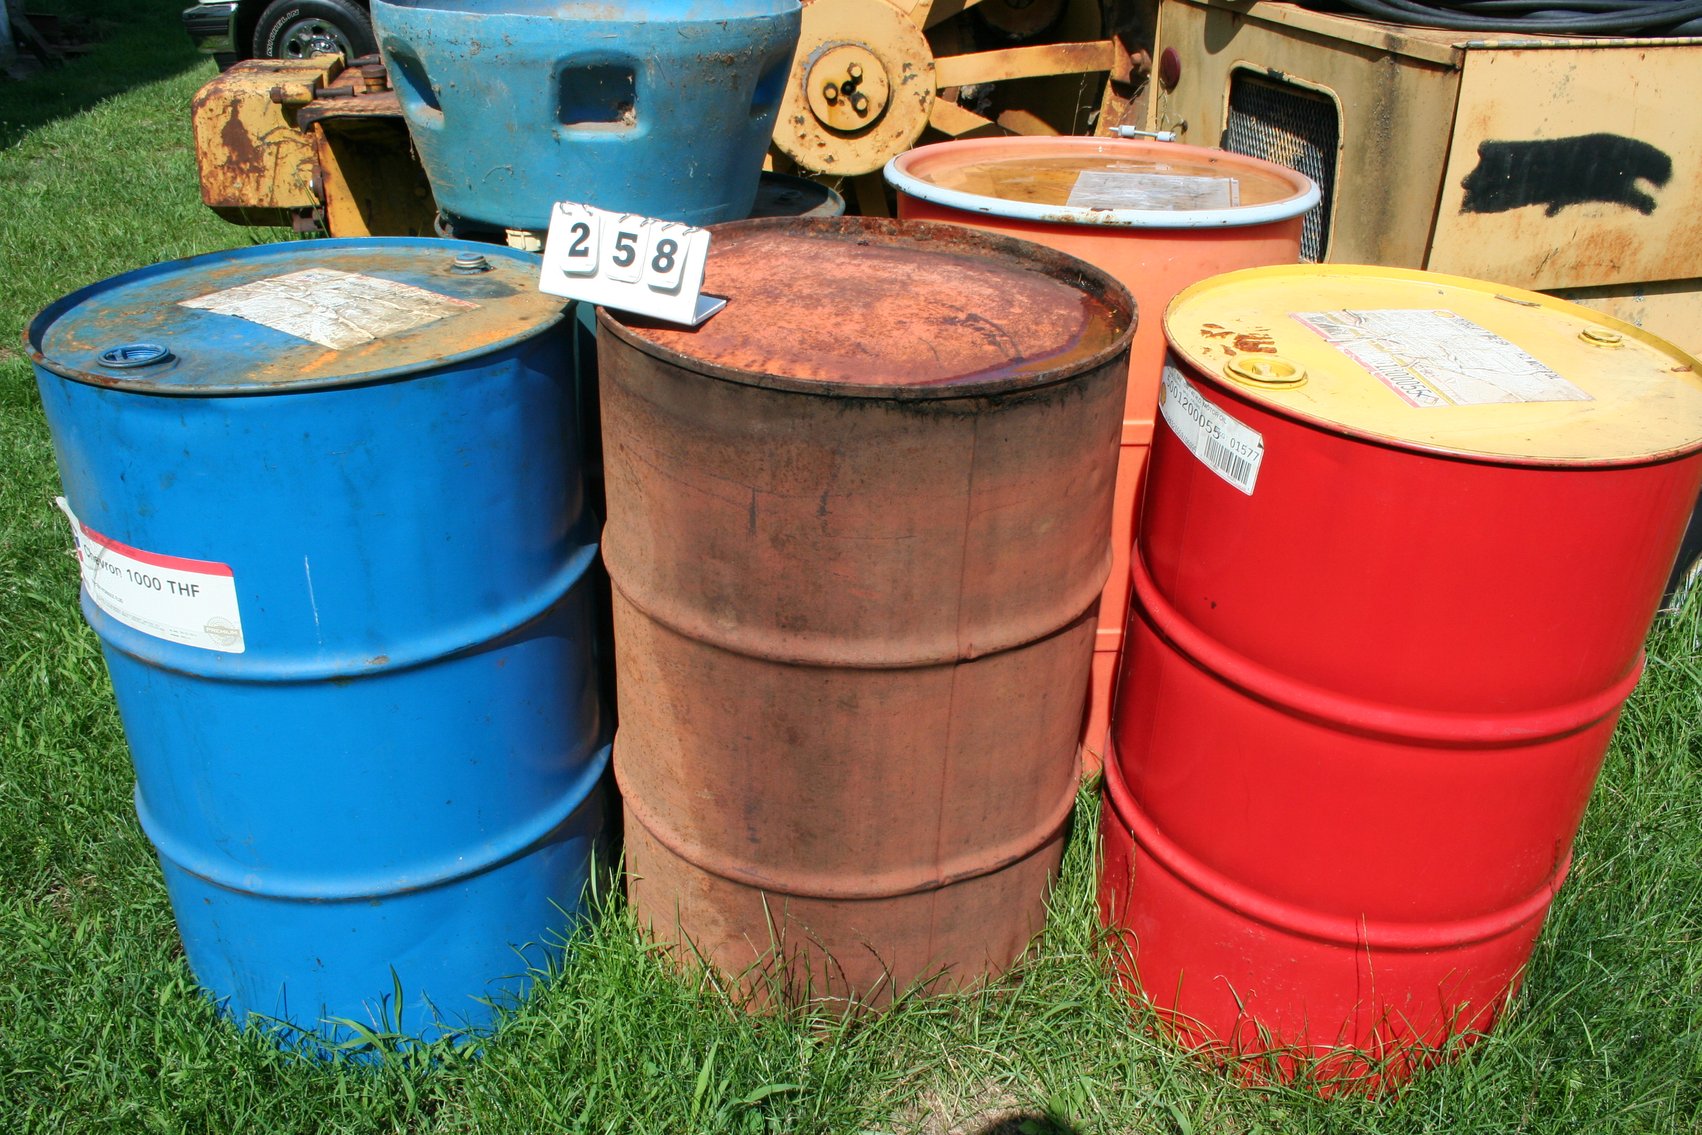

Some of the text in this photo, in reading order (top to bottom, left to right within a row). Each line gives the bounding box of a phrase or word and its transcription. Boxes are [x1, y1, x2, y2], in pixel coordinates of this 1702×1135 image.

[266, 8, 300, 57] MICHELIN
[1230, 437, 1260, 462] 01577
[126, 568, 162, 592] 1000
[167, 580, 200, 598] THF
